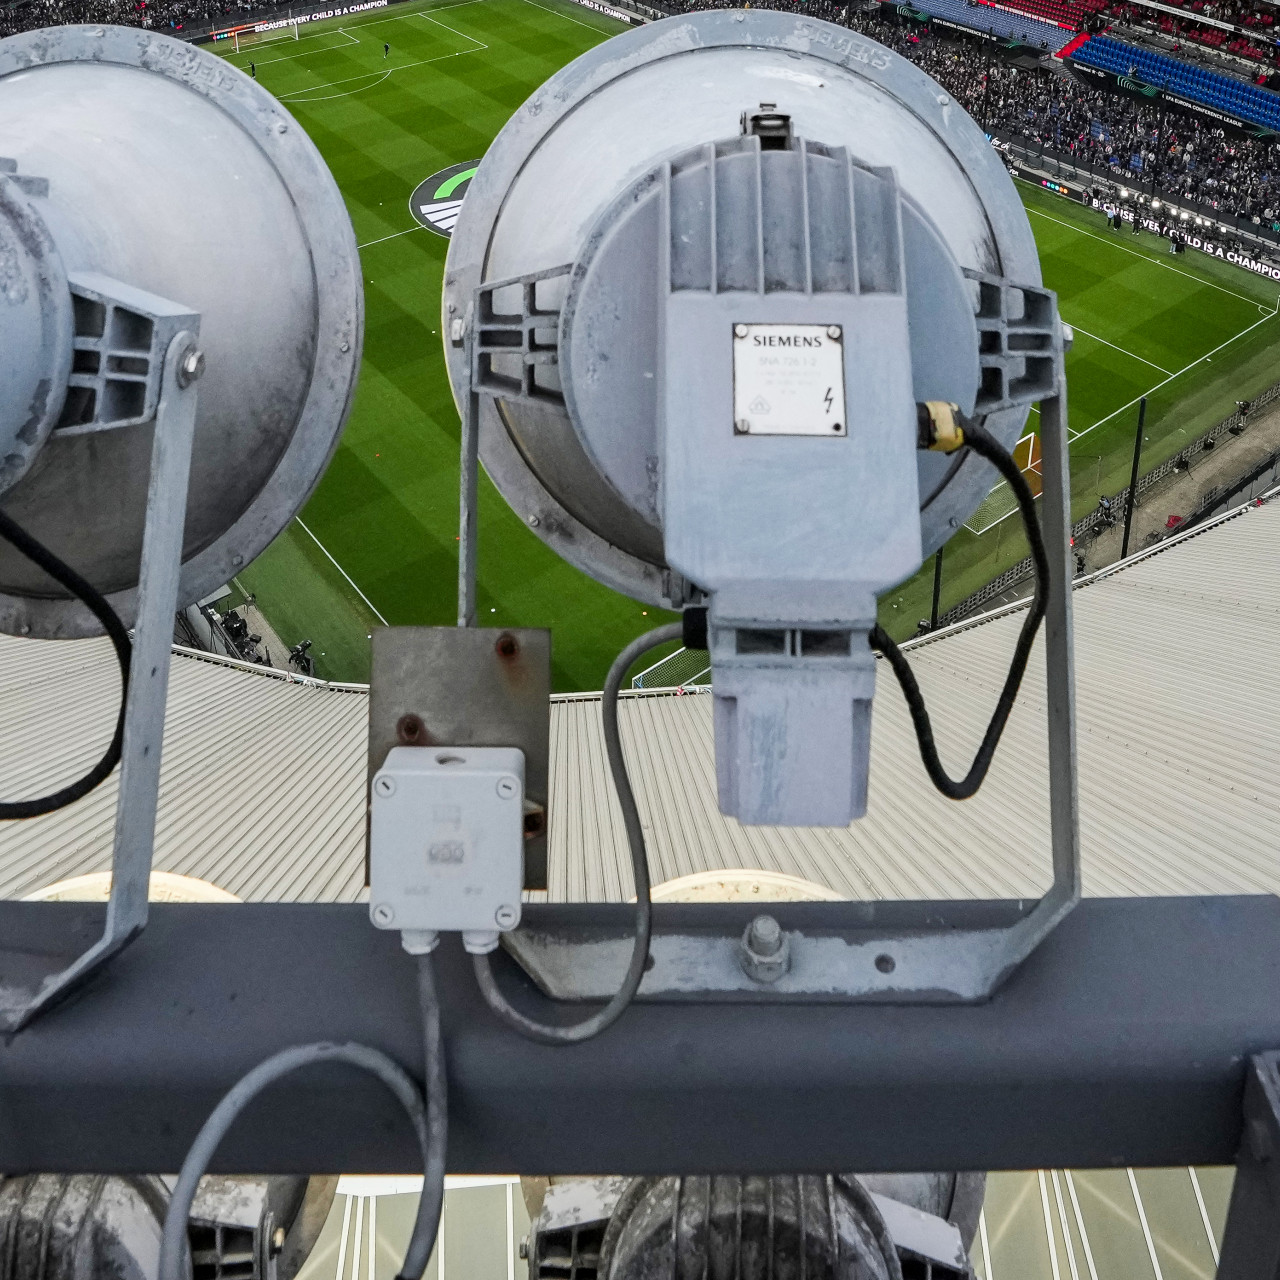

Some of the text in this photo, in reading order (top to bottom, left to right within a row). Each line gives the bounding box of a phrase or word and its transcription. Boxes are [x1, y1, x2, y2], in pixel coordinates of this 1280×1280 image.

[254, 20, 287, 33] BECAUSE
[288, 14, 311, 26] EVERY
[312, 10, 334, 21] CHILD
[349, 0, 388, 13] CHAMPION
[604, 6, 631, 23] CHAMPION
[957, 25, 981, 36] CONFERENCE
[1174, 98, 1192, 109] EUROPA
[1192, 105, 1222, 121] CONFERENCE
[1223, 116, 1243, 128] LEAGUE
[1204, 241, 1213, 253] IS
[1215, 247, 1224, 258] A
[753, 335, 822, 348] SIEMENS
